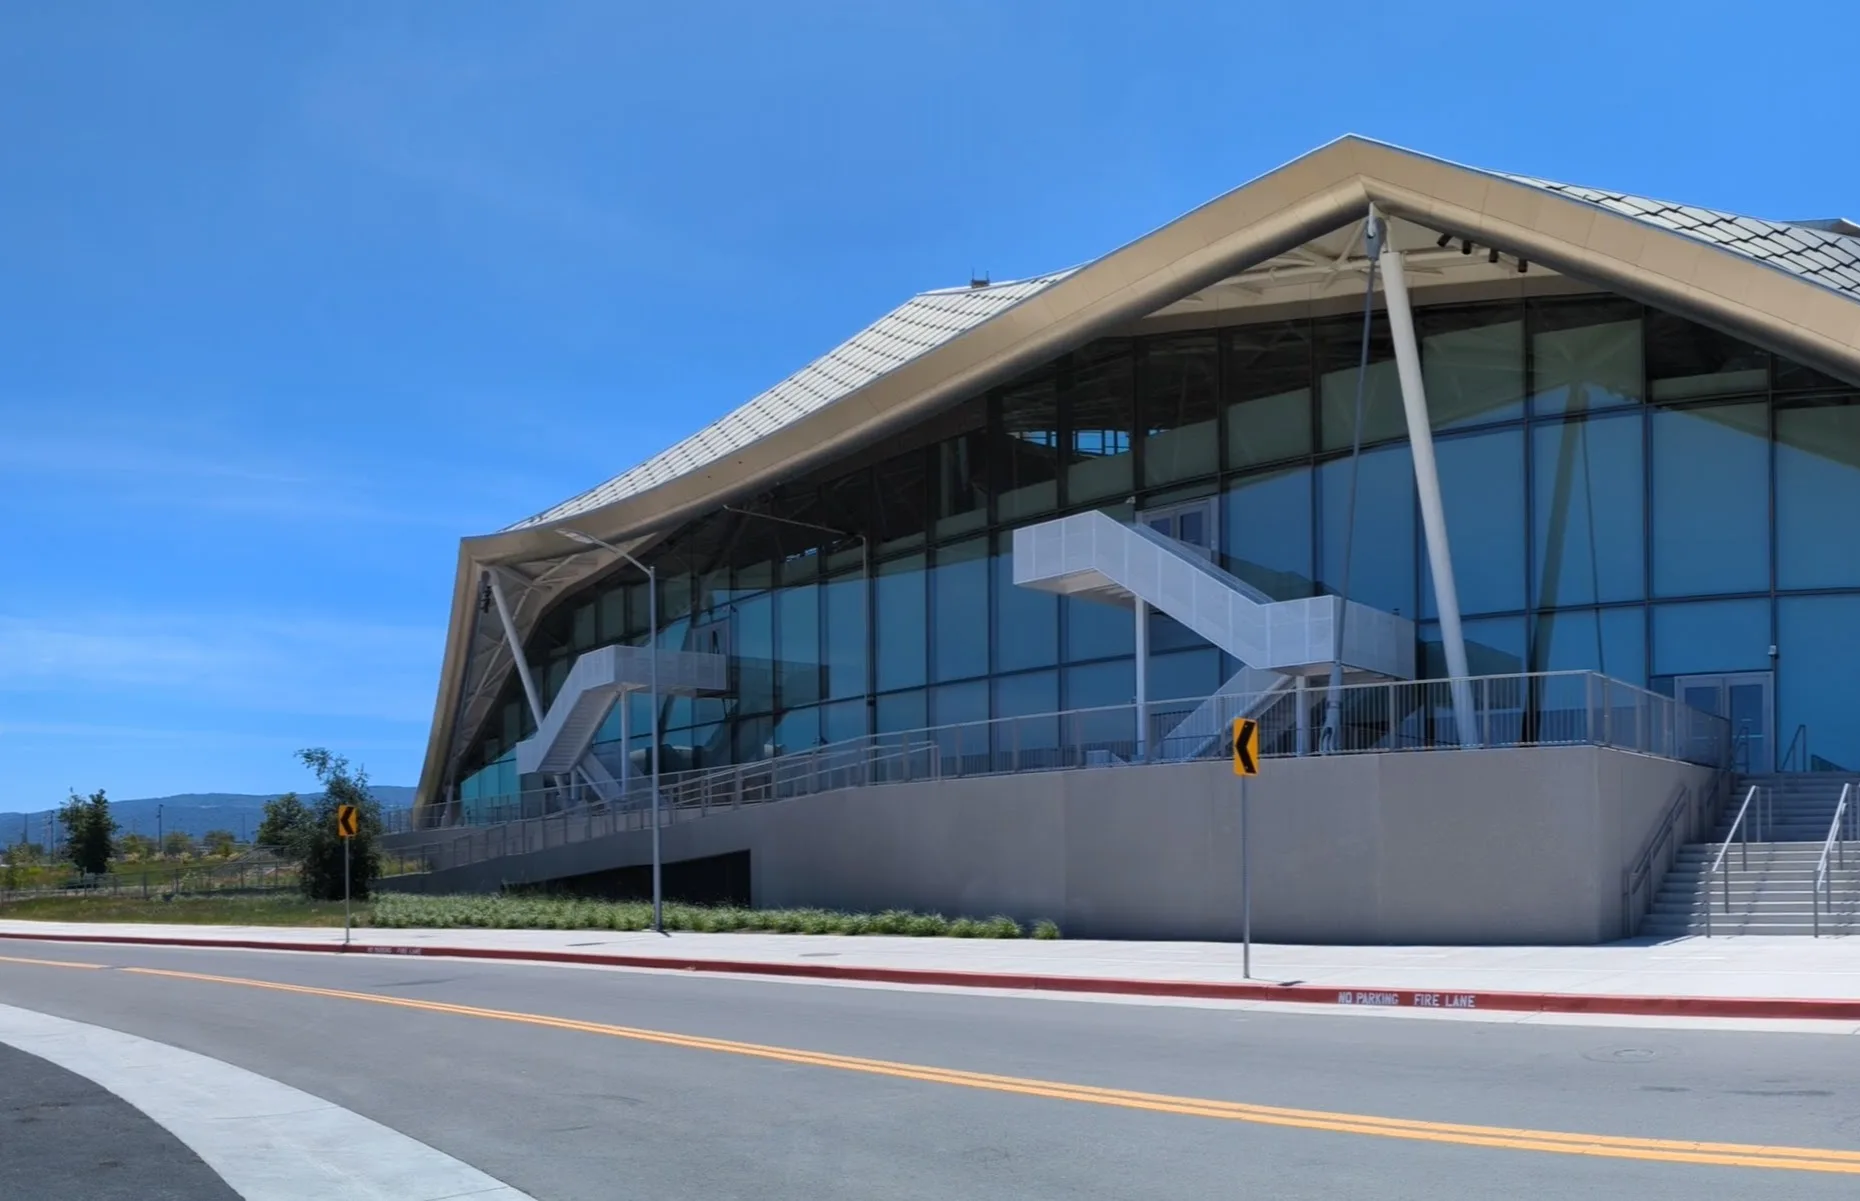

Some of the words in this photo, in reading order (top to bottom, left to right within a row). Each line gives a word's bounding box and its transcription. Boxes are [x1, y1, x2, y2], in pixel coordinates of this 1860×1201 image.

[1338, 992, 1352, 1004] NO
[1356, 993, 1399, 1005] PARKING
[1414, 994, 1440, 1007] FIRE
[1445, 996, 1475, 1008] LANE
